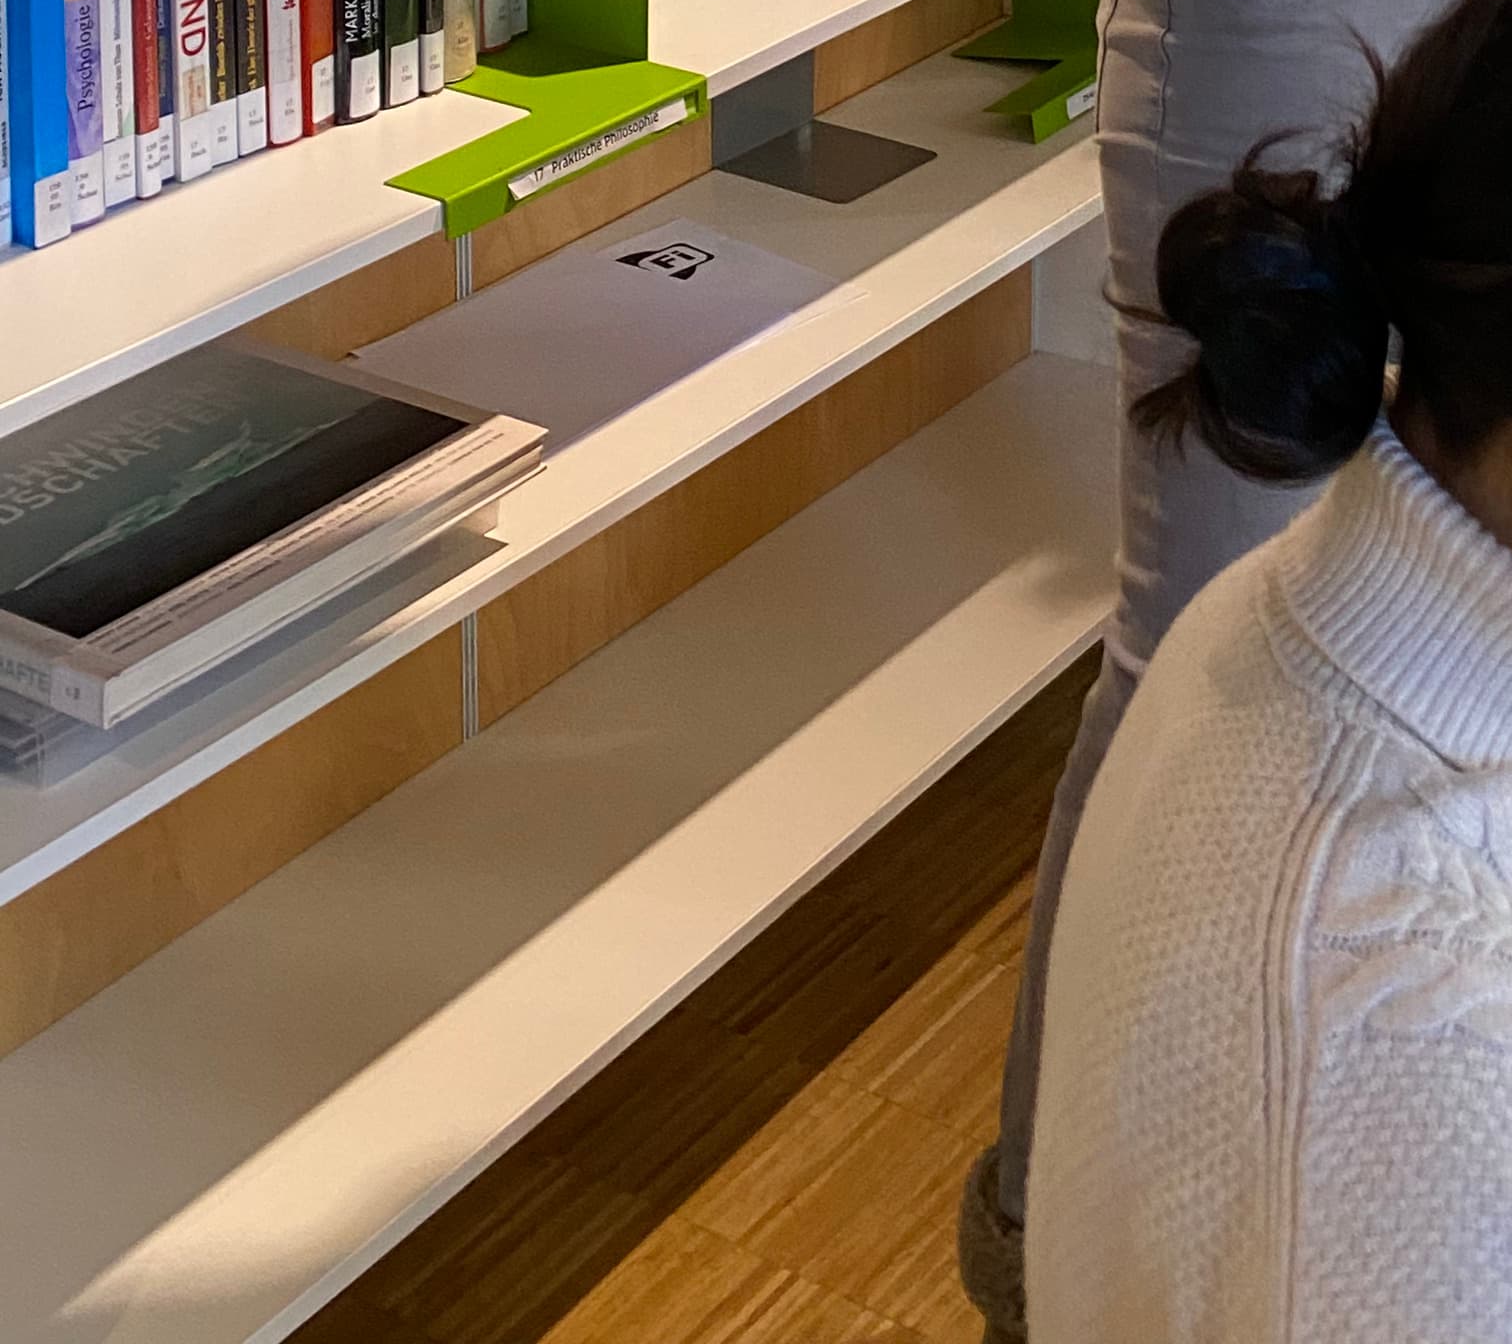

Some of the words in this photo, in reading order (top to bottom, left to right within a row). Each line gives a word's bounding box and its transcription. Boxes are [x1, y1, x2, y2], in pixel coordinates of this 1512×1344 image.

[74, 4, 94, 112] Psychologie
[533, 167, 545, 182] 17
[551, 138, 603, 174] Praktische
[603, 111, 659, 147] Philosophie
[649, 250, 696, 270] Fi
